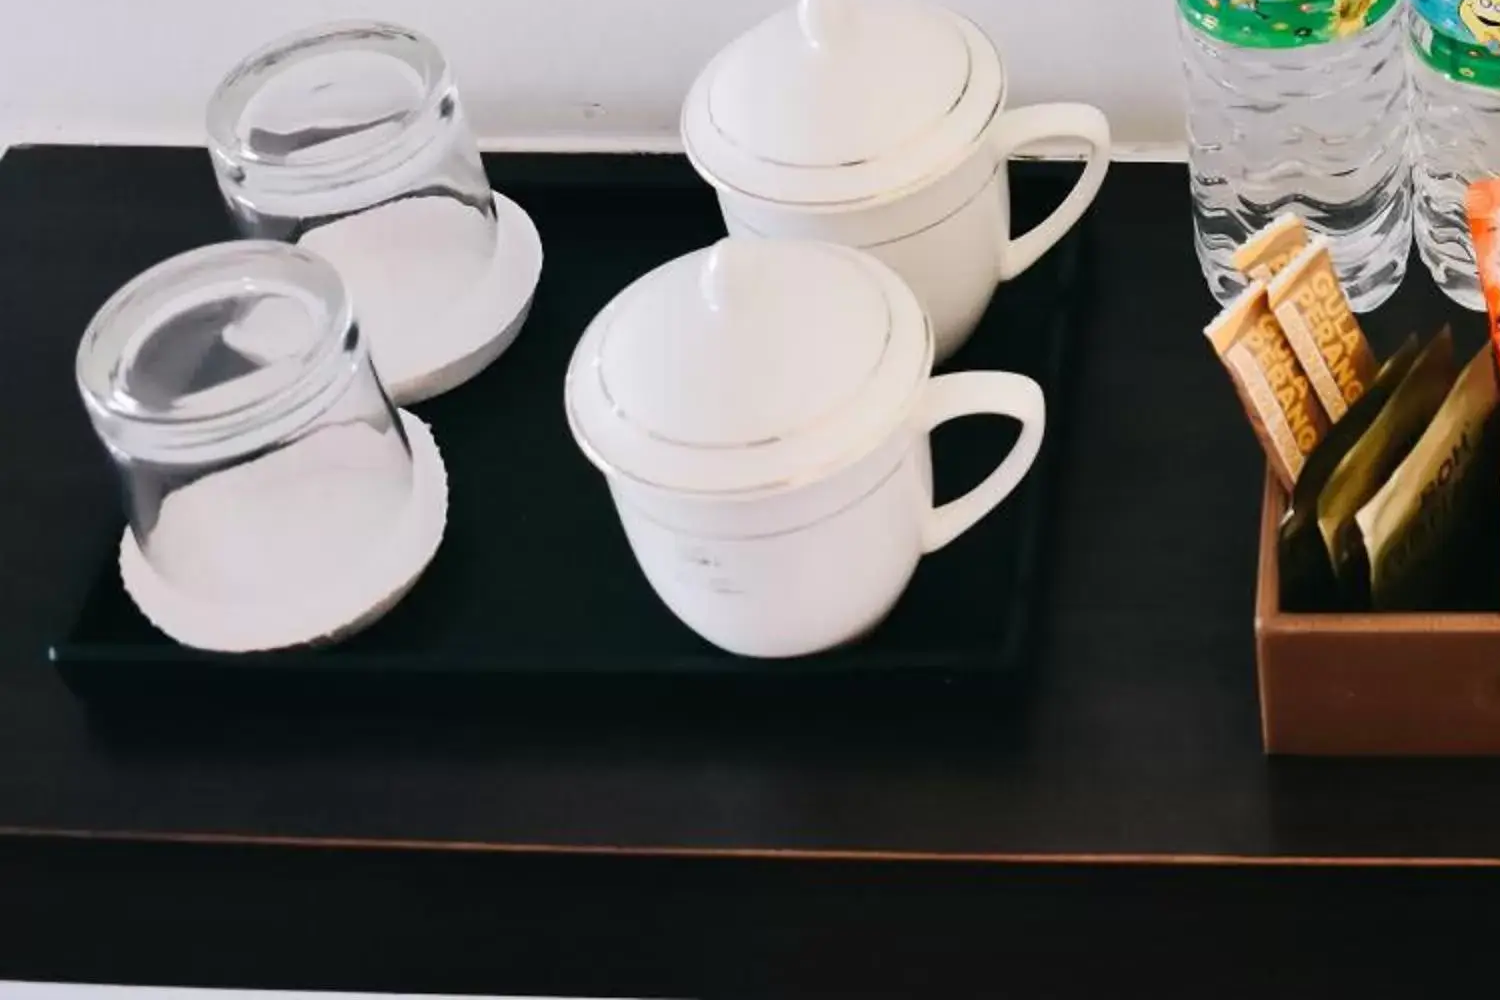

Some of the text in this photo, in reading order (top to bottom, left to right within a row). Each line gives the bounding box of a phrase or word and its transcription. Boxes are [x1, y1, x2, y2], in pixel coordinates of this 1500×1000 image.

[1258, 313, 1310, 399] GULA
[1298, 283, 1365, 403] PERANG
[1311, 269, 1361, 355] GULA
[1244, 325, 1317, 457] PERANG
